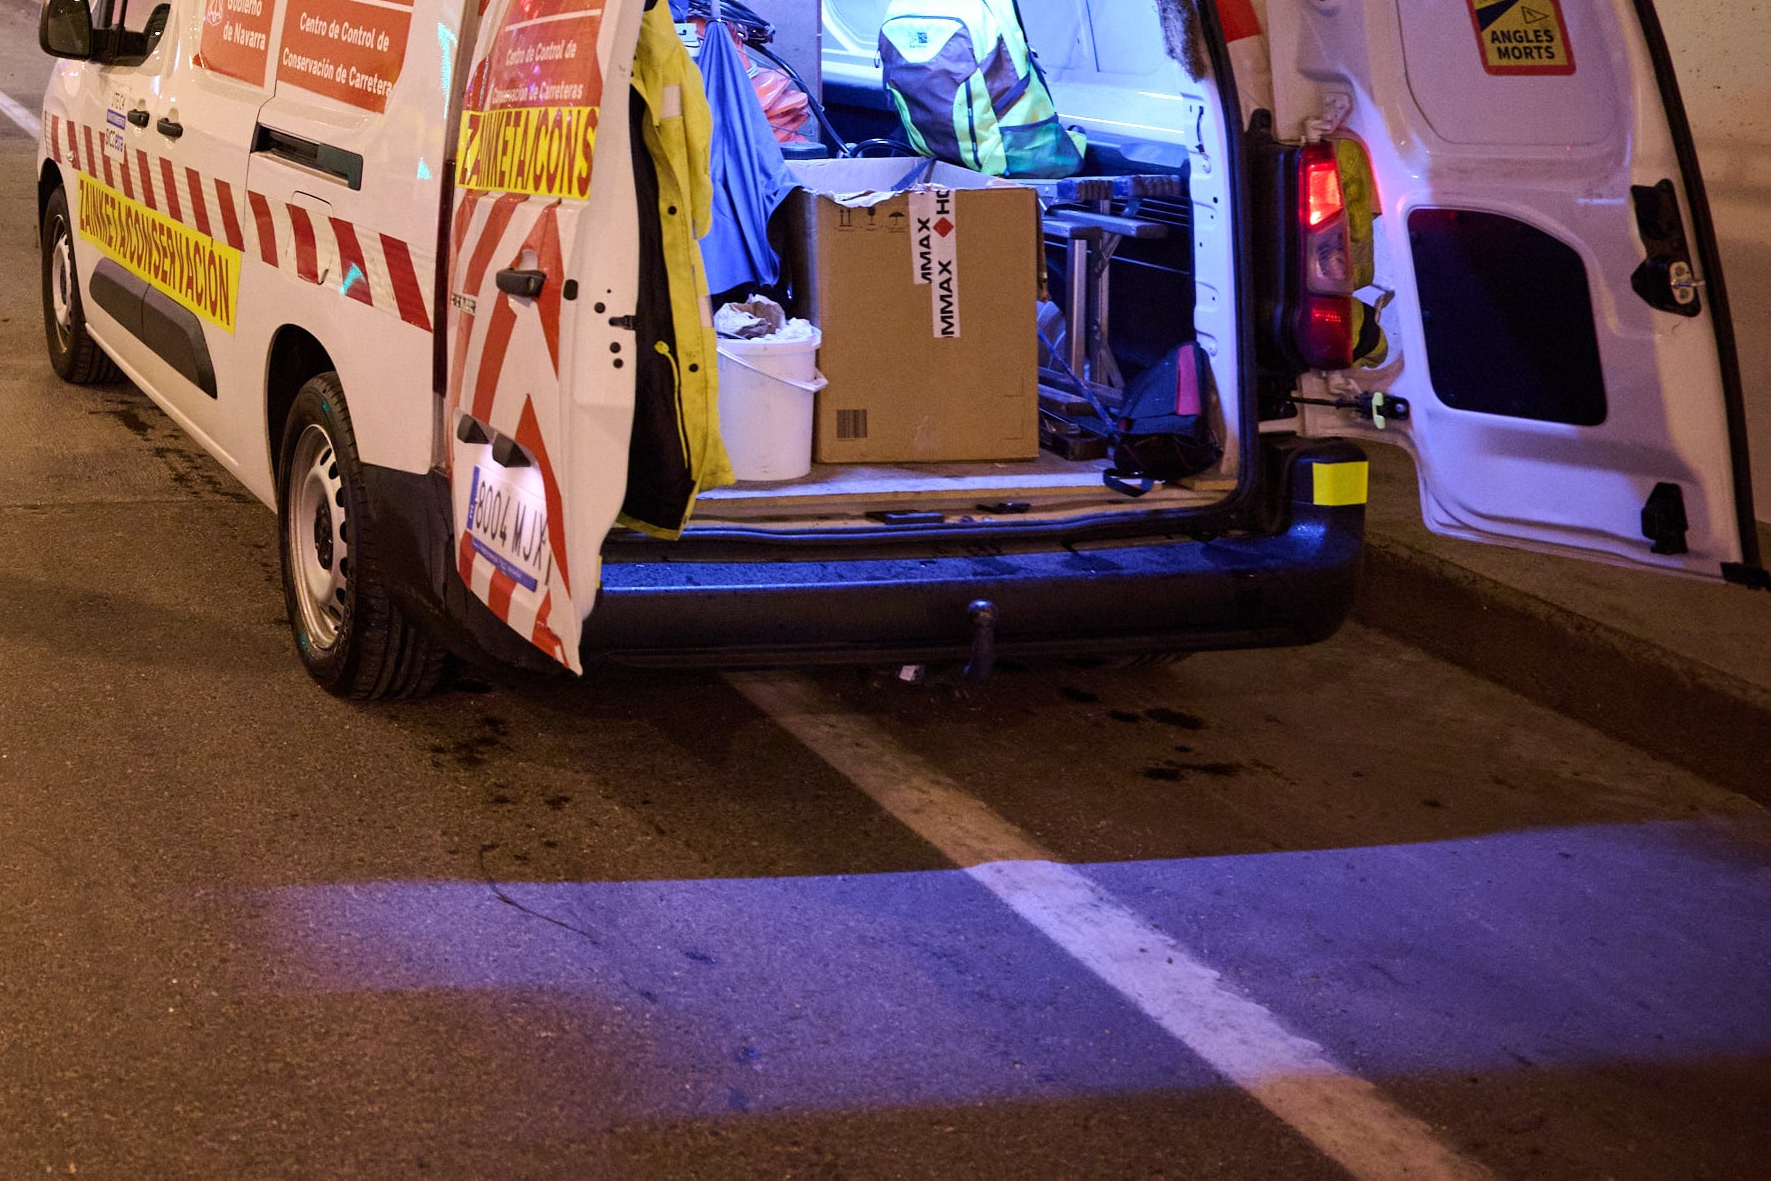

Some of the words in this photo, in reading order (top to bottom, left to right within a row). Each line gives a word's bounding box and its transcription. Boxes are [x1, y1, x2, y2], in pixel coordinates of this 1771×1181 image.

[223, 20, 233, 41] de
[234, 22, 266, 51] Navarra
[299, 12, 327, 35] Centro
[329, 19, 339, 39] de
[341, 21, 375, 49] Control
[377, 31, 389, 52] de
[1491, 30, 1554, 44] ANGLES
[282, 47, 335, 80] Conservación
[335, 63, 347, 84] de
[348, 66, 394, 96] Carretera
[506, 47, 525, 66] Centro
[525, 45, 535, 62] de
[535, 39, 564, 62] Control
[564, 39, 577, 59] de
[1497, 46, 1555, 60] MORTS
[530, 84, 539, 101] de
[539, 81, 583, 100] Carreteras
[459, 108, 598, 197] ZAINKETA/CONS
[79, 179, 230, 326] ZAINKETA/CONSERVACIÓN
[938, 260, 955, 338] MMAX
[476, 480, 511, 547] 8004
